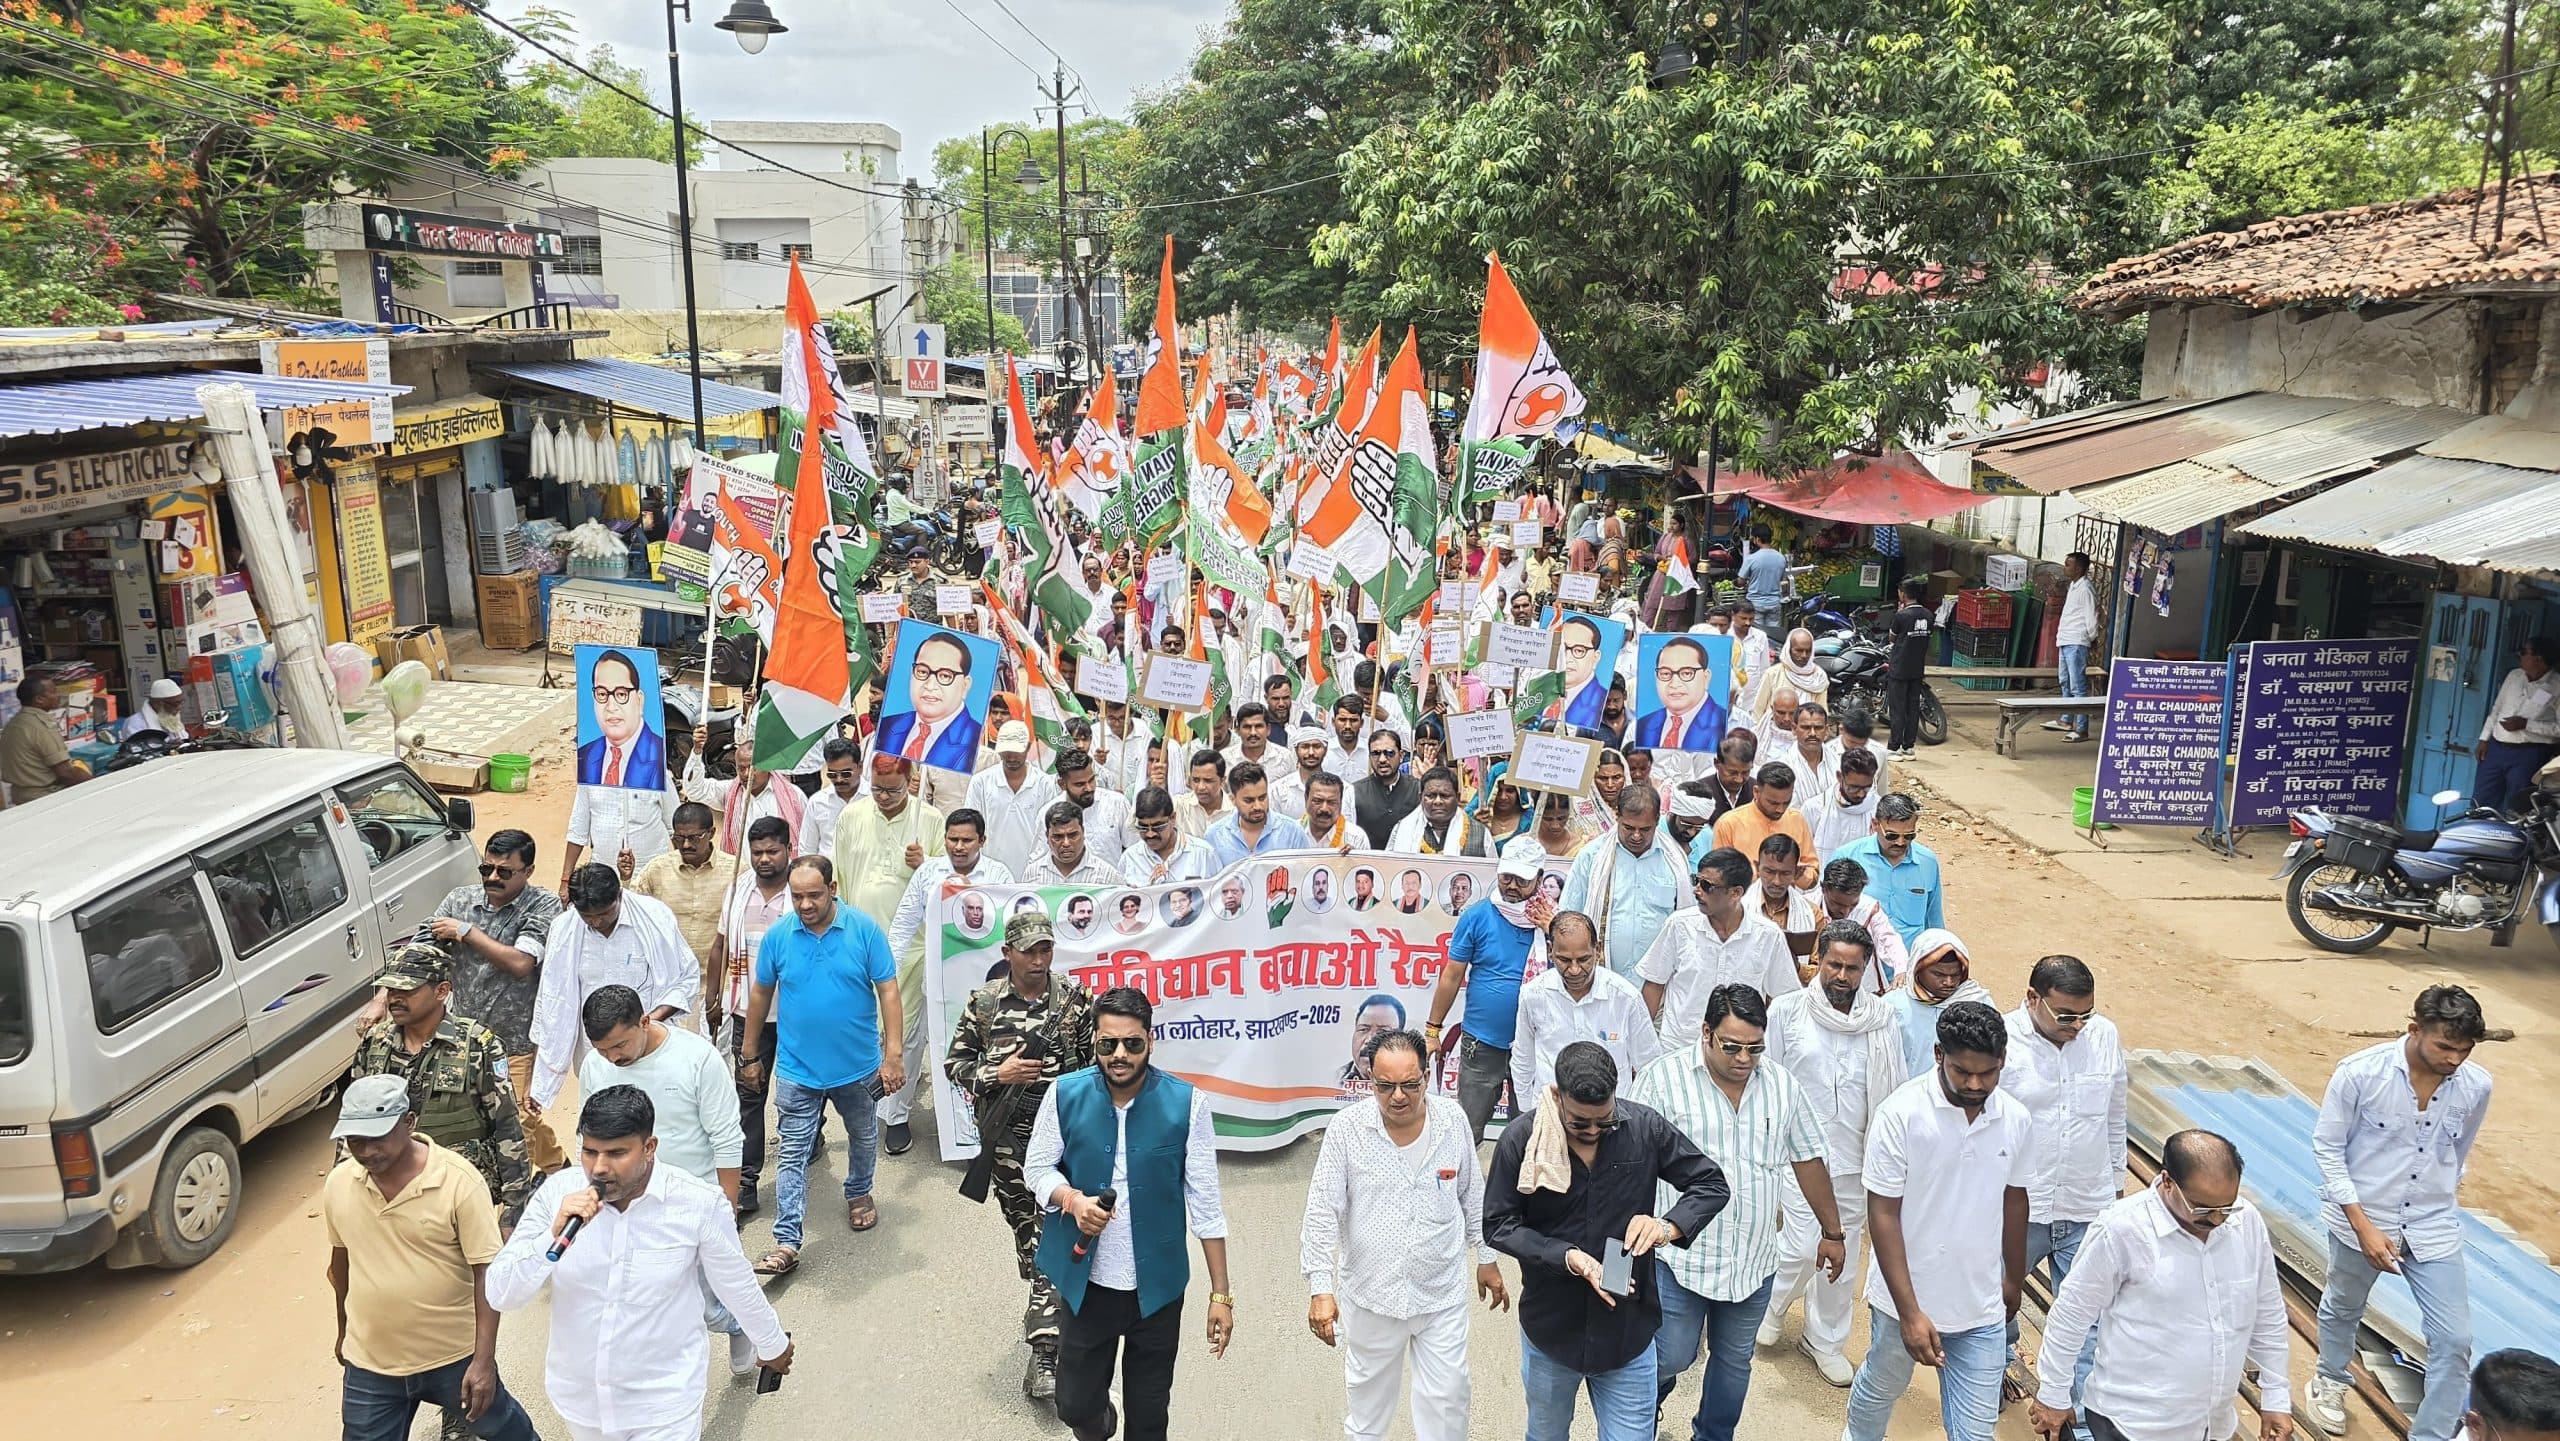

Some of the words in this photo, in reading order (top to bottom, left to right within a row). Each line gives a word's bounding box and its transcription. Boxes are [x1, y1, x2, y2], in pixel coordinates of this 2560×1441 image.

[914, 361, 931, 380] V
[910, 380, 936, 390] MART
[69, 445, 191, 493] ELECTRICALS
[746, 471, 776, 487] SCHOO
[741, 496, 775, 512] ADMISSIO
[714, 508, 740, 544] OUTH
[2262, 652, 2307, 667] जनता
[2314, 648, 2372, 665] मेडिकल
[2378, 646, 2409, 666] हॉल
[2172, 665, 2205, 677] मेडिकल
[2260, 679, 2288, 695] डॉ.
[2298, 681, 2353, 695] लक्ष्मण
[2361, 680, 2410, 694] प्रसाद
[2159, 702, 2223, 713] CHAUDHARY
[2254, 713, 2282, 729] डॉ.
[2292, 712, 2339, 728] पंकज
[2347, 714, 2395, 730] कुमार
[2107, 744, 2120, 757] Dr.
[2123, 745, 2169, 758] KAMLESH
[2174, 746, 2220, 760] CHANDRA
[2255, 744, 2282, 760] डॉ.
[2292, 745, 2338, 760] श्रवण
[2345, 745, 2393, 762] कुमार
[2140, 758, 2183, 771] कमलेश
[2246, 776, 2274, 793] डॉ.
[2284, 775, 2344, 792] प्रियंका
[2351, 774, 2388, 791] सिंह
[2102, 788, 2118, 799] Dr.
[2120, 789, 2156, 800] SUNIL
[2158, 790, 2214, 801] KANDULA
[2128, 800, 2163, 814] सुनील
[1253, 928, 1382, 994] बचाओ
[1166, 1013, 1241, 1042] लातेहार,
[1245, 1010, 1299, 1041] झारखण्ड
